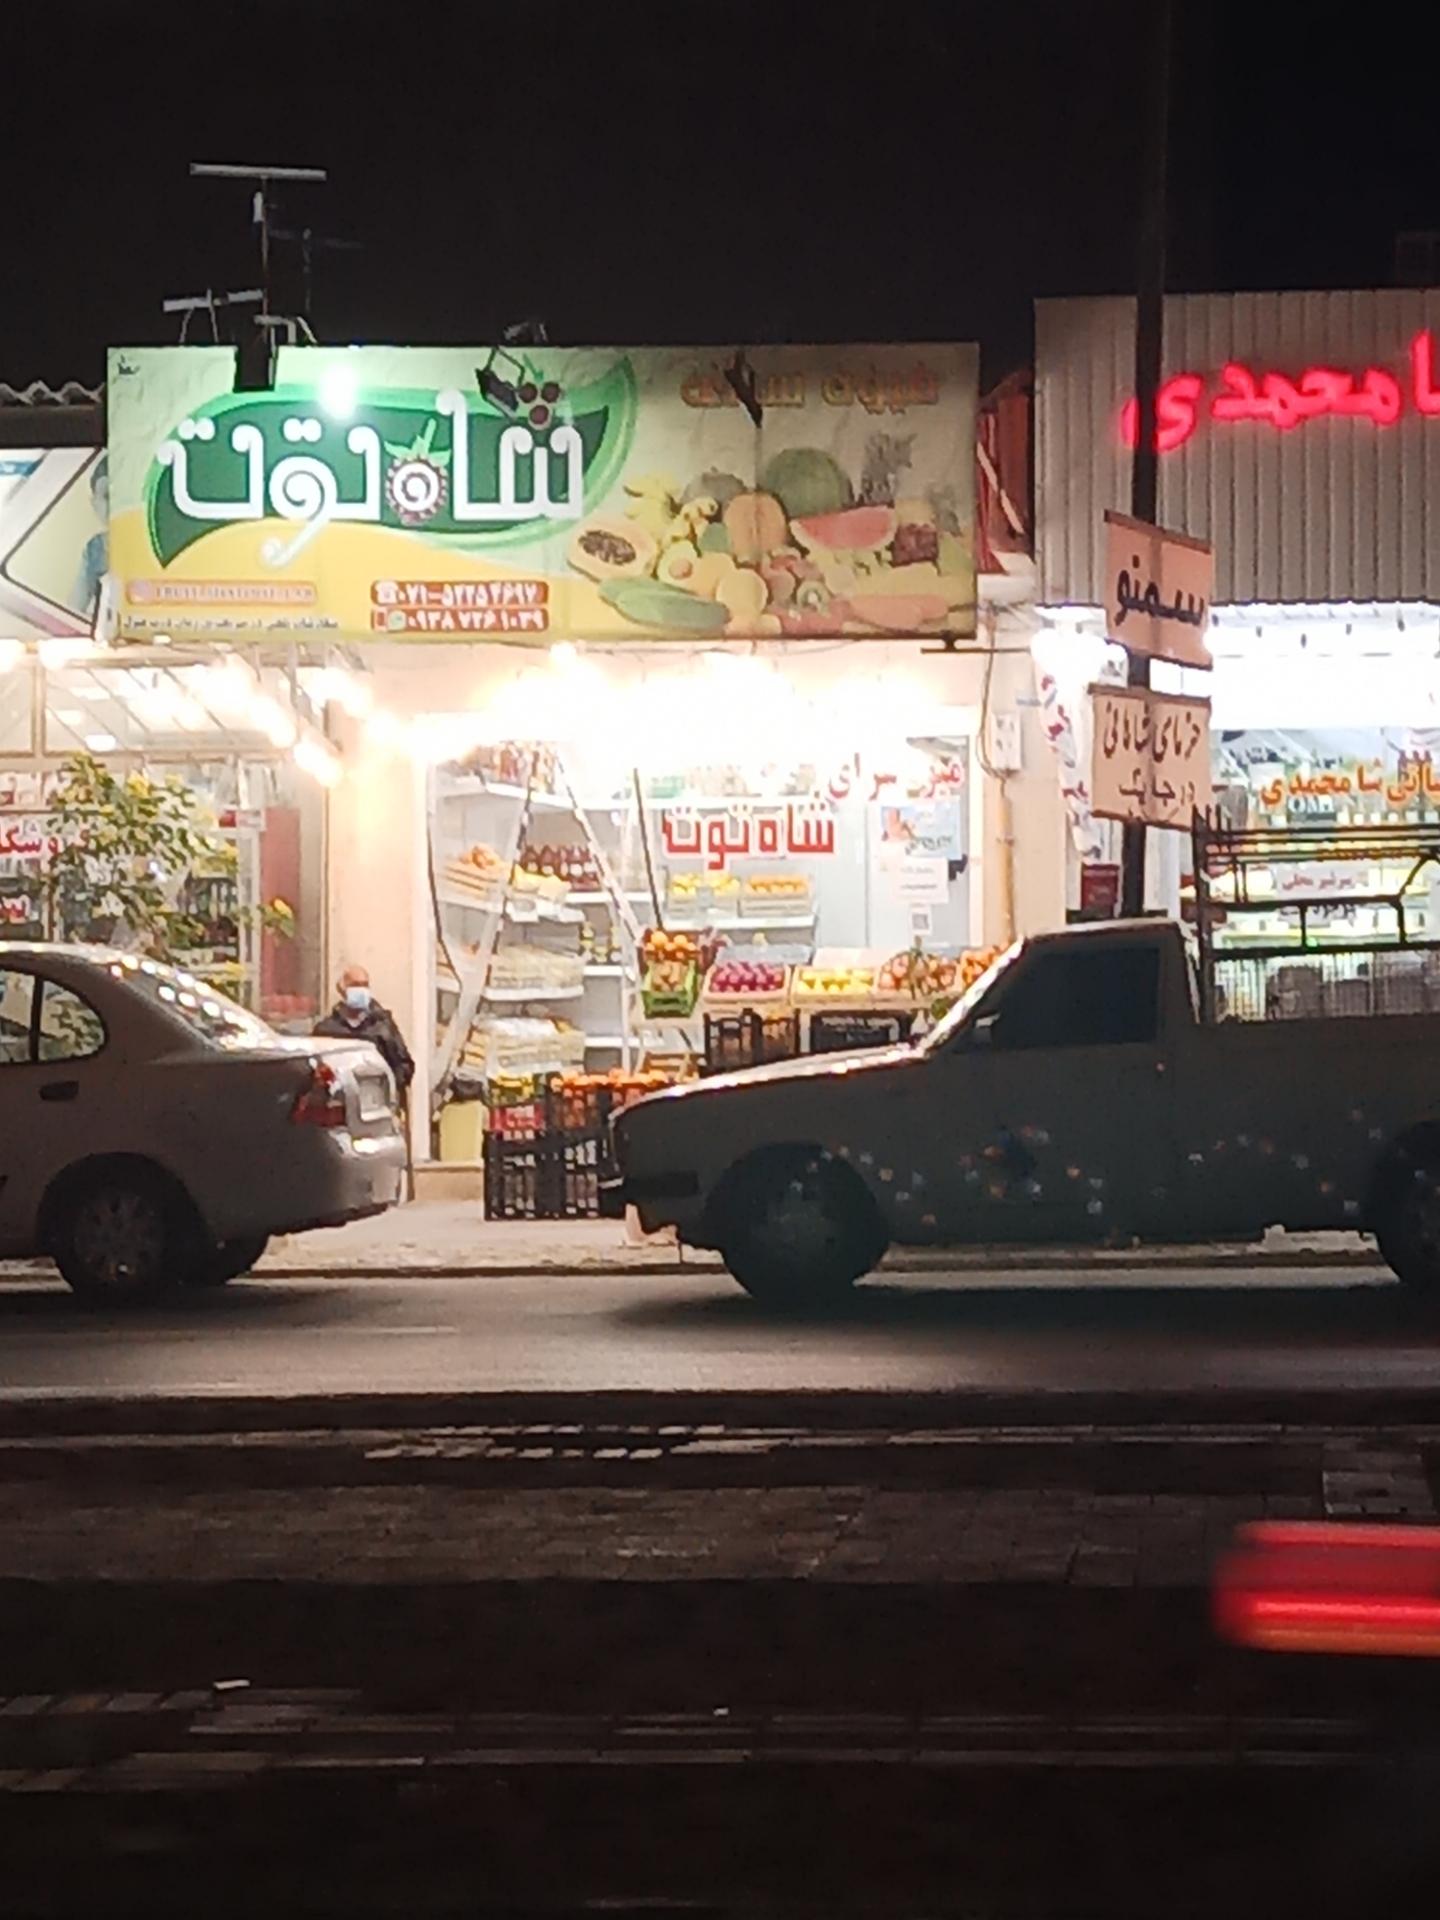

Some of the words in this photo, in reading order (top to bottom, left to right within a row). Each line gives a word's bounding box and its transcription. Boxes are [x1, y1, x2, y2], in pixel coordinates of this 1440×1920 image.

[1114, 554, 1205, 626] سمنو
[660, 802, 751, 871] توت
[758, 793, 836, 855] شاه
